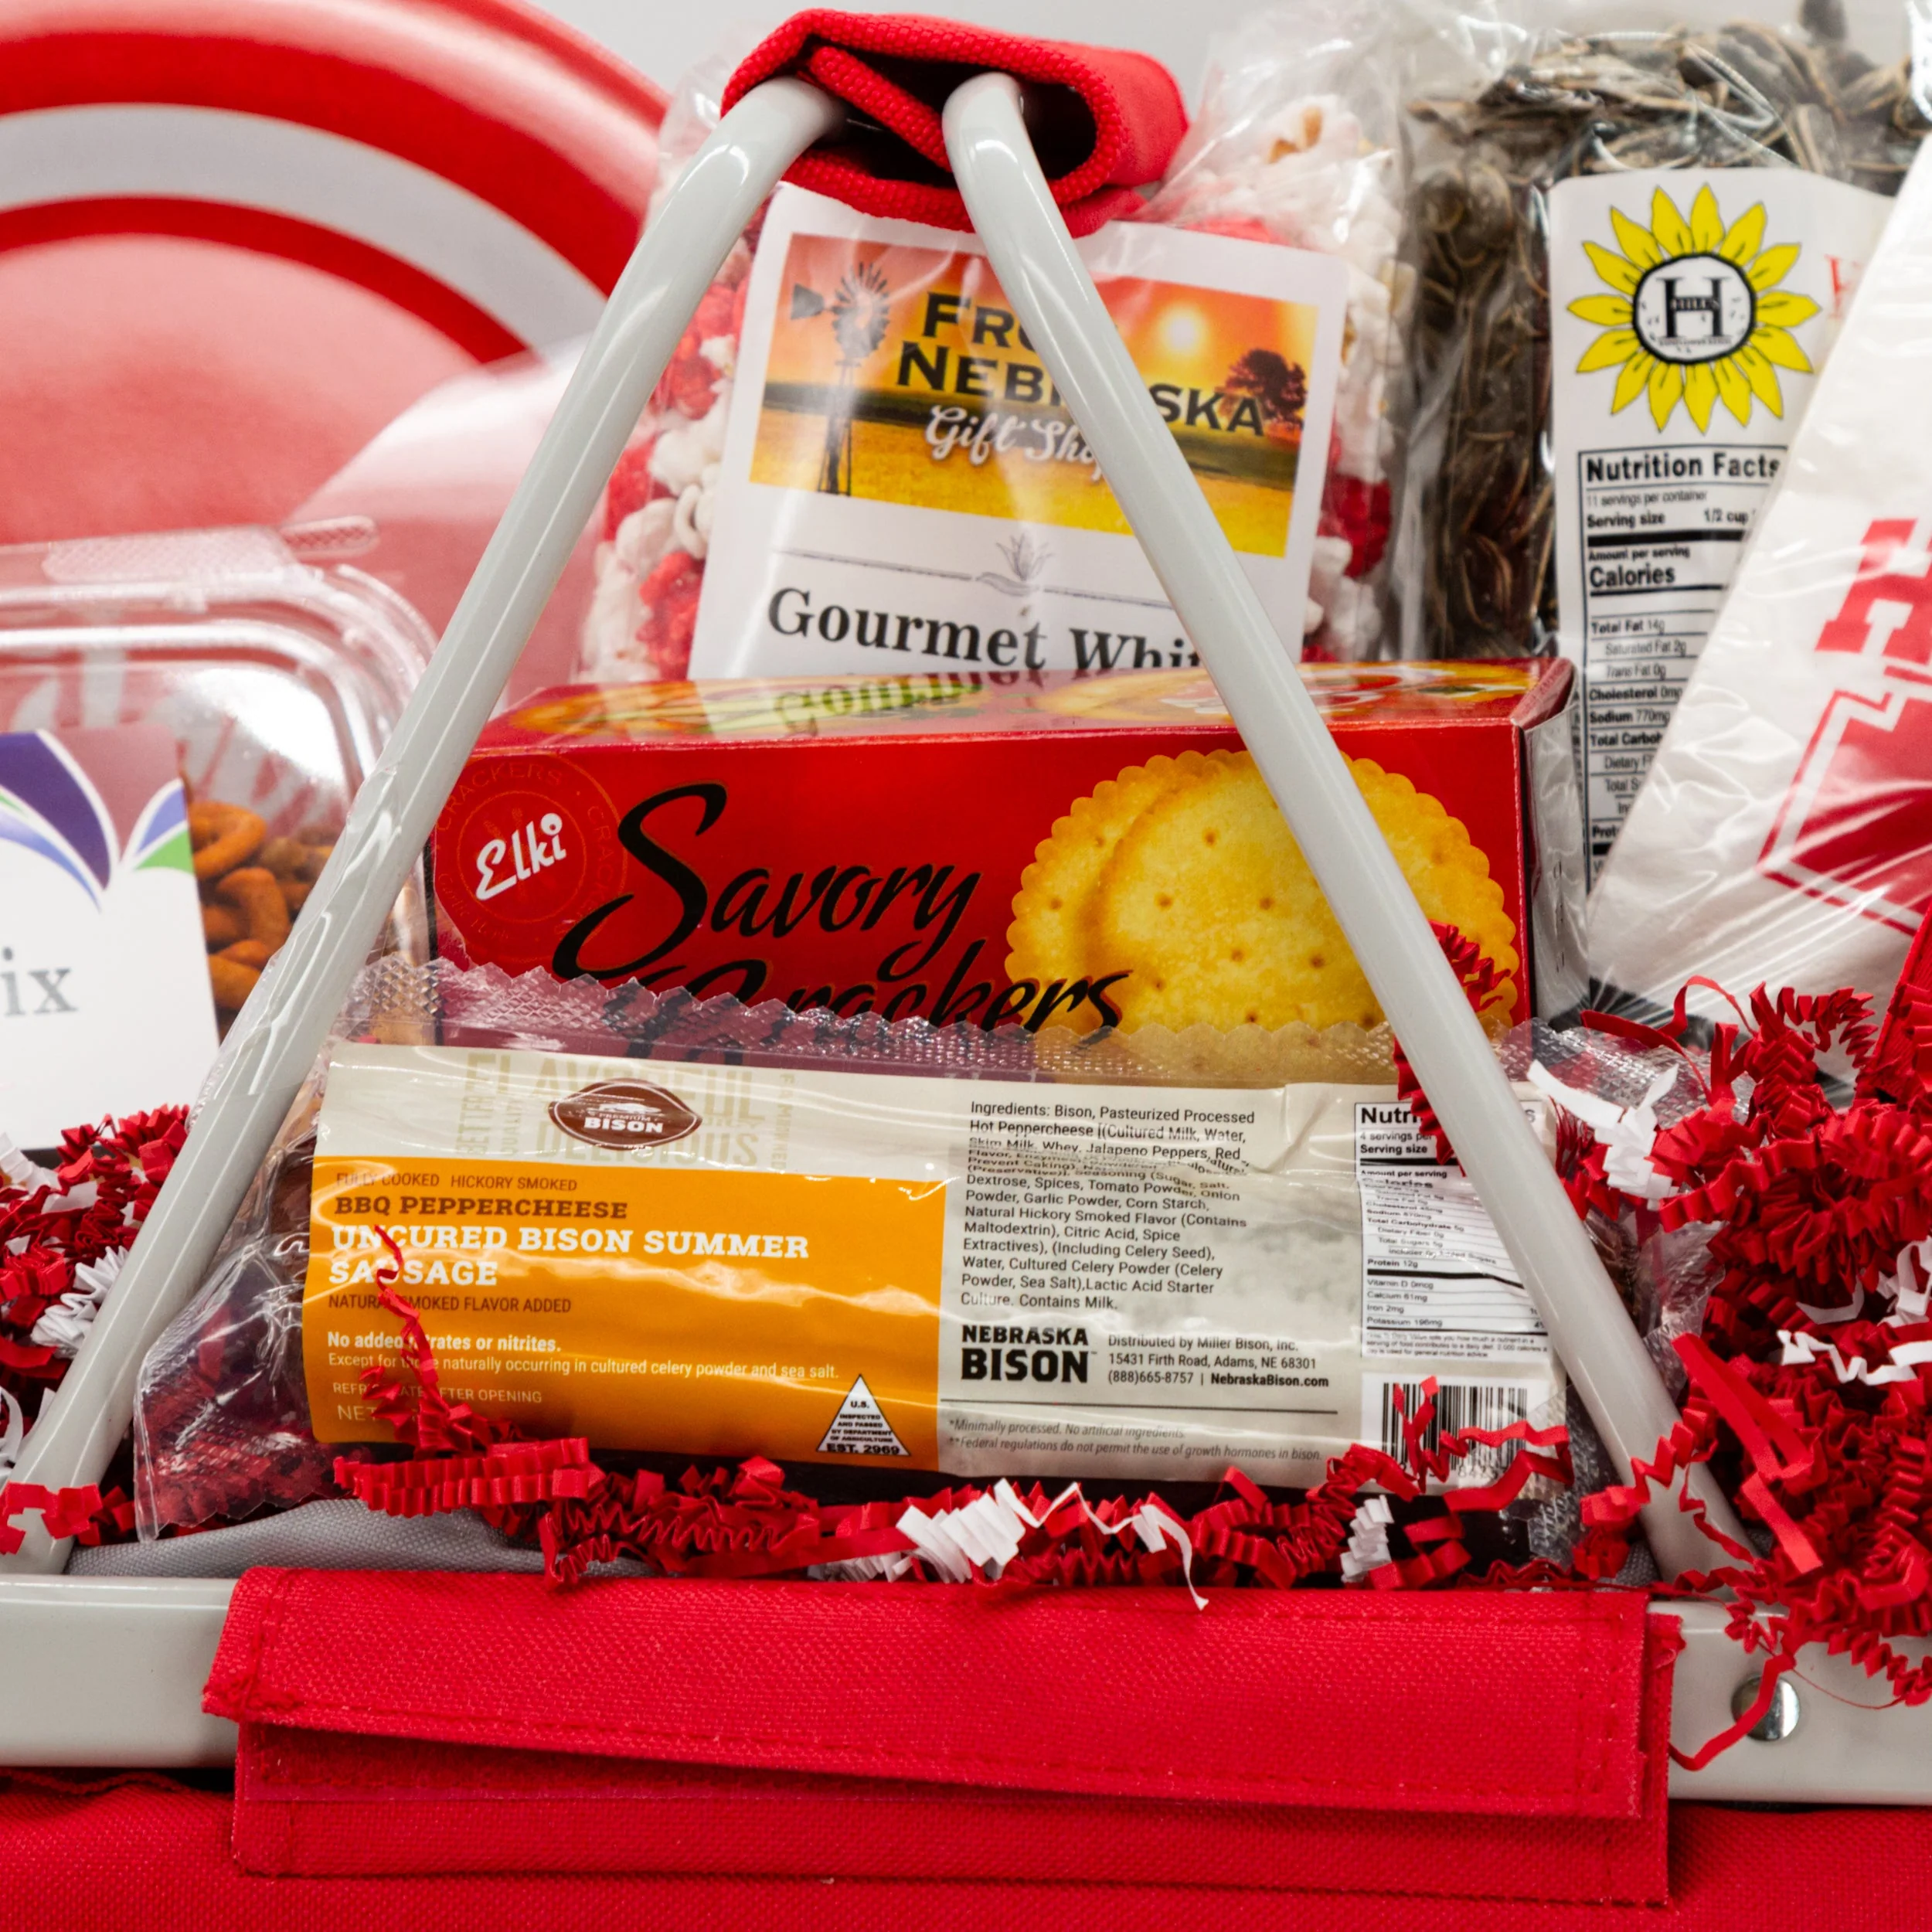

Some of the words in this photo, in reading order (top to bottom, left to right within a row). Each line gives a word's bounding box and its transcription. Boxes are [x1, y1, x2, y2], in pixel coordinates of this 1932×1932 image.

[923, 292, 1036, 353] FR
[896, 340, 1265, 437] NEBSKA
[925, 405, 1027, 466] Gift
[1587, 452, 1703, 482] Nutrition
[1713, 452, 1781, 478] Facts
[1601, 493, 1641, 508] servings
[1644, 492, 1659, 506] per
[1662, 490, 1707, 502] container
[1587, 513, 1636, 528] Serving
[1640, 511, 1665, 525] size
[1704, 509, 1723, 522] 1/2
[1726, 511, 1749, 525] cup
[1588, 549, 1628, 562] Amount
[1631, 548, 1649, 561] per
[1652, 546, 1690, 558] serving
[1590, 564, 1675, 588] Calories
[768, 587, 1047, 670] Gourmet
[1591, 621, 1621, 634] Total
[1625, 620, 1644, 632] Fat
[1605, 641, 1652, 655] Saturated
[1655, 640, 1671, 653] Fat
[1590, 685, 1657, 701] Cholesterol
[1590, 709, 1633, 724] Sodium
[1590, 733, 1618, 747] Total
[476, 813, 567, 901] Elki
[551, 780, 983, 983] Savory
[971, 1101, 1050, 1117] Ingredients:
[1055, 1104, 1096, 1120] Bison,
[1100, 1107, 1179, 1122] Pasteurized
[1184, 1110, 1255, 1124] Processed
[583, 1117, 663, 1134] BISON
[970, 1121, 994, 1134] Hot
[998, 1121, 1094, 1138] Peppercheese
[1168, 1127, 1199, 1142] Milk,
[1205, 1128, 1247, 1144] Water,
[1370, 1131, 1413, 1142] servings
[1086, 1142, 1148, 1158] Jalapeno
[1152, 1145, 1211, 1161] Peppers,
[1216, 1148, 1240, 1160] Red
[1361, 1144, 1403, 1155] Serving
[1406, 1144, 1428, 1153] size
[336, 1172, 376, 1187] FULLY
[382, 1172, 440, 1187] COOKED
[451, 1175, 513, 1190] HICKORY
[518, 1177, 577, 1192] SMOKED
[967, 1175, 1030, 1189] Dextrose,
[1035, 1177, 1084, 1191] Spices,
[1088, 1179, 1139, 1193] Tomato
[1145, 1182, 1196, 1198] Powder,
[1201, 1189, 1240, 1201] Onion
[335, 1196, 390, 1216] BBQ
[400, 1196, 628, 1219] PEPPERCHEESE
[966, 1189, 1019, 1204] Powder,
[1024, 1192, 1063, 1205] Garlic
[1068, 1194, 1122, 1209] Powder,
[1126, 1198, 1158, 1210] Corn
[1162, 1198, 1209, 1213] Starch,
[964, 1206, 1015, 1218] Natural
[1019, 1208, 1071, 1223] Hickory
[1075, 1210, 1130, 1223] Smoked
[1135, 1213, 1177, 1226] Flavor
[1181, 1213, 1247, 1229] (Contains
[332, 1224, 508, 1250] UNCURED
[518, 1226, 634, 1253] BISON
[643, 1230, 809, 1259] SUMMER
[964, 1223, 1060, 1238] Maltodextrin),
[1064, 1226, 1100, 1239] Citric
[1104, 1227, 1138, 1242] Acid,
[1143, 1230, 1181, 1243] Spice
[963, 1239, 1047, 1256] Extractives),
[1052, 1243, 1121, 1260] (Including
[1125, 1245, 1168, 1261] Celery
[1172, 1247, 1216, 1262] Seed),
[328, 1258, 498, 1286] SAUSAGE
[963, 1256, 1005, 1271] Water,
[1009, 1258, 1066, 1272] Cultured
[1071, 1260, 1114, 1276] Celery
[1118, 1261, 1171, 1276] Powder
[1174, 1264, 1223, 1280] (Celery
[1367, 1258, 1400, 1268] Protein
[1403, 1260, 1419, 1269] 12g
[961, 1274, 1015, 1289] Powder,
[1019, 1275, 1046, 1289] Sea
[1132, 1279, 1162, 1293] Acid
[1167, 1281, 1215, 1294] Starter
[1367, 1279, 1398, 1288] Vitamin
[329, 1294, 383, 1309] NATURA
[464, 1298, 519, 1312] FLAVOR
[523, 1298, 572, 1313] ADDED
[961, 1292, 1014, 1307] Culture.
[1019, 1294, 1080, 1308] Contains
[1084, 1296, 1119, 1310] Milk.
[1367, 1291, 1402, 1300] Calcium
[1367, 1316, 1411, 1326] Potassium
[328, 1332, 350, 1348] No
[476, 1336, 492, 1351] or
[497, 1334, 562, 1352] nitrites.
[961, 1324, 1090, 1346] NEBRASKA
[1107, 1334, 1175, 1349] Distributed
[1179, 1335, 1193, 1352] by
[1197, 1336, 1232, 1351] Miller
[1236, 1338, 1272, 1352] Bison,
[328, 1353, 374, 1369] Except
[378, 1354, 396, 1368] for
[443, 1356, 502, 1374] naturally
[505, 1359, 570, 1376] occurring
[574, 1358, 587, 1373] in
[591, 1359, 647, 1375] cultured
[651, 1361, 692, 1378] celery
[696, 1362, 747, 1378] powder
[751, 1363, 777, 1378] and
[781, 1365, 805, 1379] sea
[810, 1364, 839, 1380] salt.
[960, 1347, 1090, 1384] BISON
[1108, 1352, 1145, 1366] 15431
[1148, 1354, 1174, 1367] Firth
[1179, 1355, 1211, 1369] Road,
[1215, 1356, 1257, 1371] Adams,
[1261, 1357, 1277, 1370] NE
[1281, 1357, 1316, 1370] 68301
[1107, 1369, 1194, 1386] (888)665-8757
[1210, 1372, 1329, 1388] NebraskaBison.com
[478, 1389, 542, 1403] OPENING
[1009, 1422, 1062, 1437] processed.
[1065, 1423, 1080, 1435] No
[827, 1443, 859, 1454] EST.
[863, 1444, 901, 1455] 2969
[1000, 1437, 1057, 1453] regulations
[1060, 1440, 1073, 1452] do
[1077, 1441, 1093, 1453] not
[1095, 1442, 1130, 1457] permit
[1133, 1443, 1148, 1455] the
[1151, 1444, 1169, 1456] use
[1172, 1444, 1184, 1457] of
[1185, 1444, 1222, 1459] growth
[1223, 1446, 1276, 1460] hormones
[1278, 1447, 1289, 1460] in
[1292, 1447, 1321, 1461] bison.
